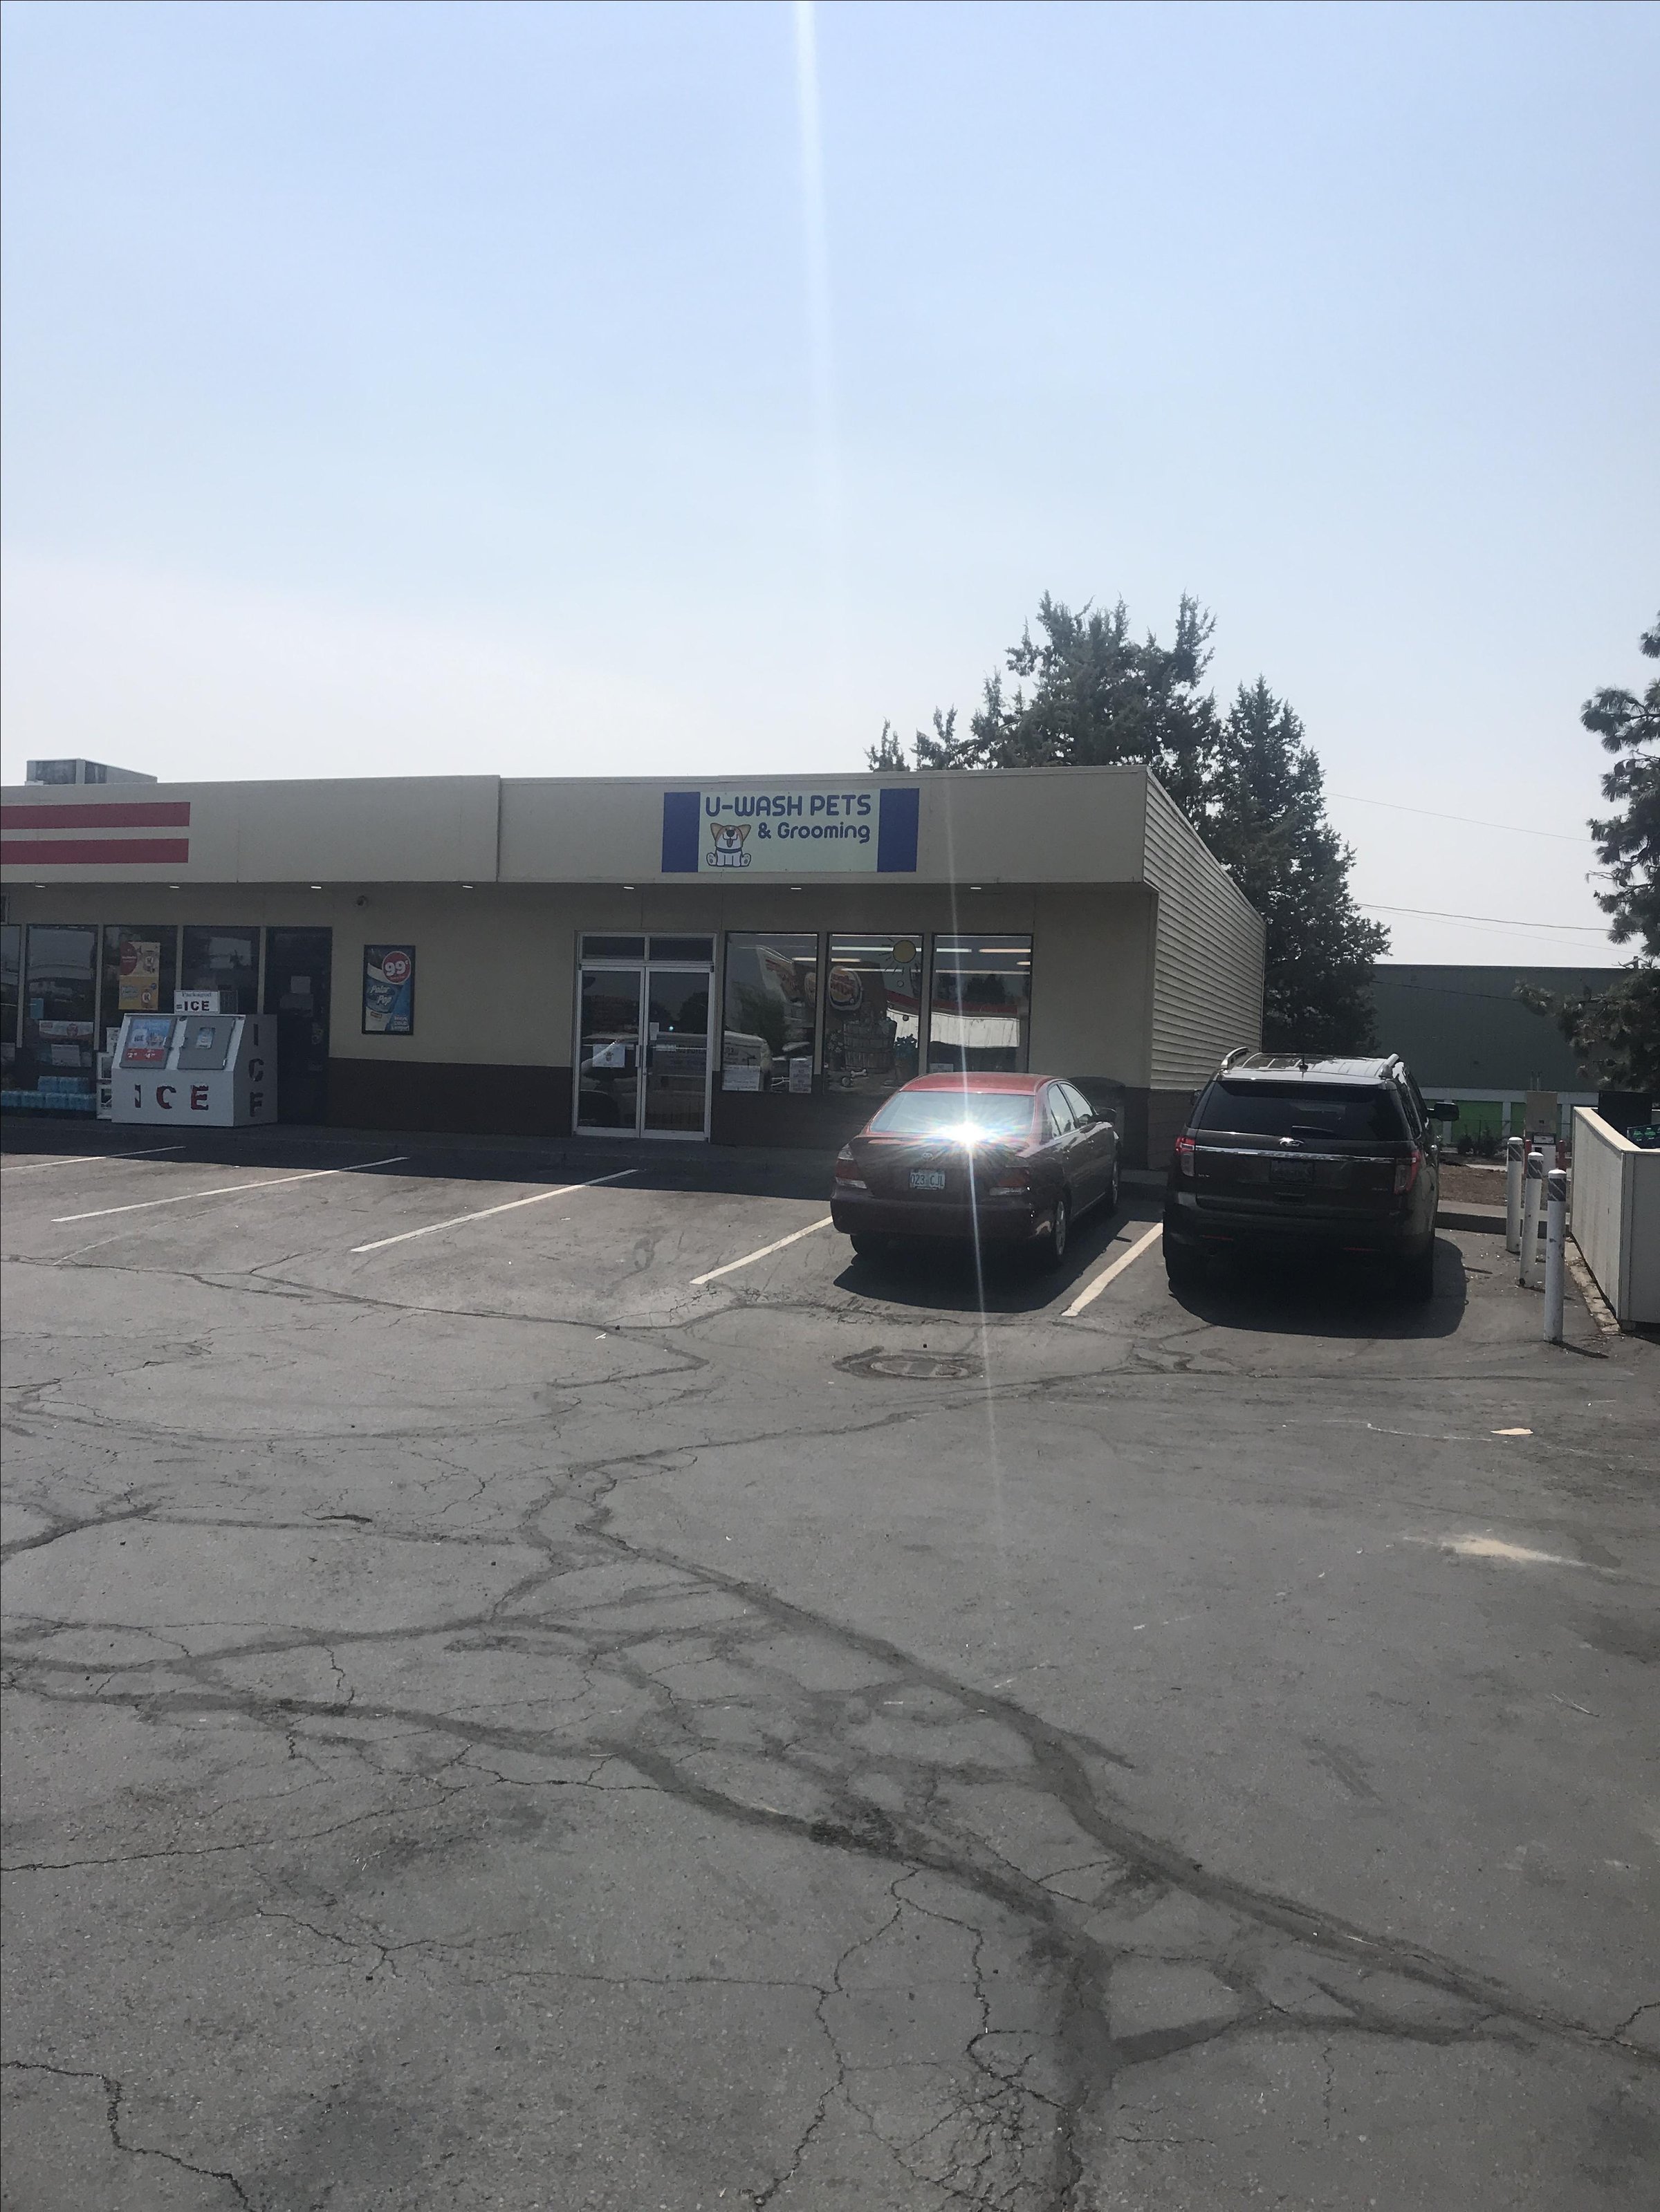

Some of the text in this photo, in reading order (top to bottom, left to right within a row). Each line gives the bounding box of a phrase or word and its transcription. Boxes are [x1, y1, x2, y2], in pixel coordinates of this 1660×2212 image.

[705, 794, 872, 817] U-WASH PETS
[757, 821, 871, 844] & Grooming
[370, 985, 390, 994] Polar
[184, 1001, 210, 1011] ICE
[377, 994, 392, 1006] Pop
[134, 1084, 209, 1110] ICE
[910, 1174, 944, 1187] 023 CJL
